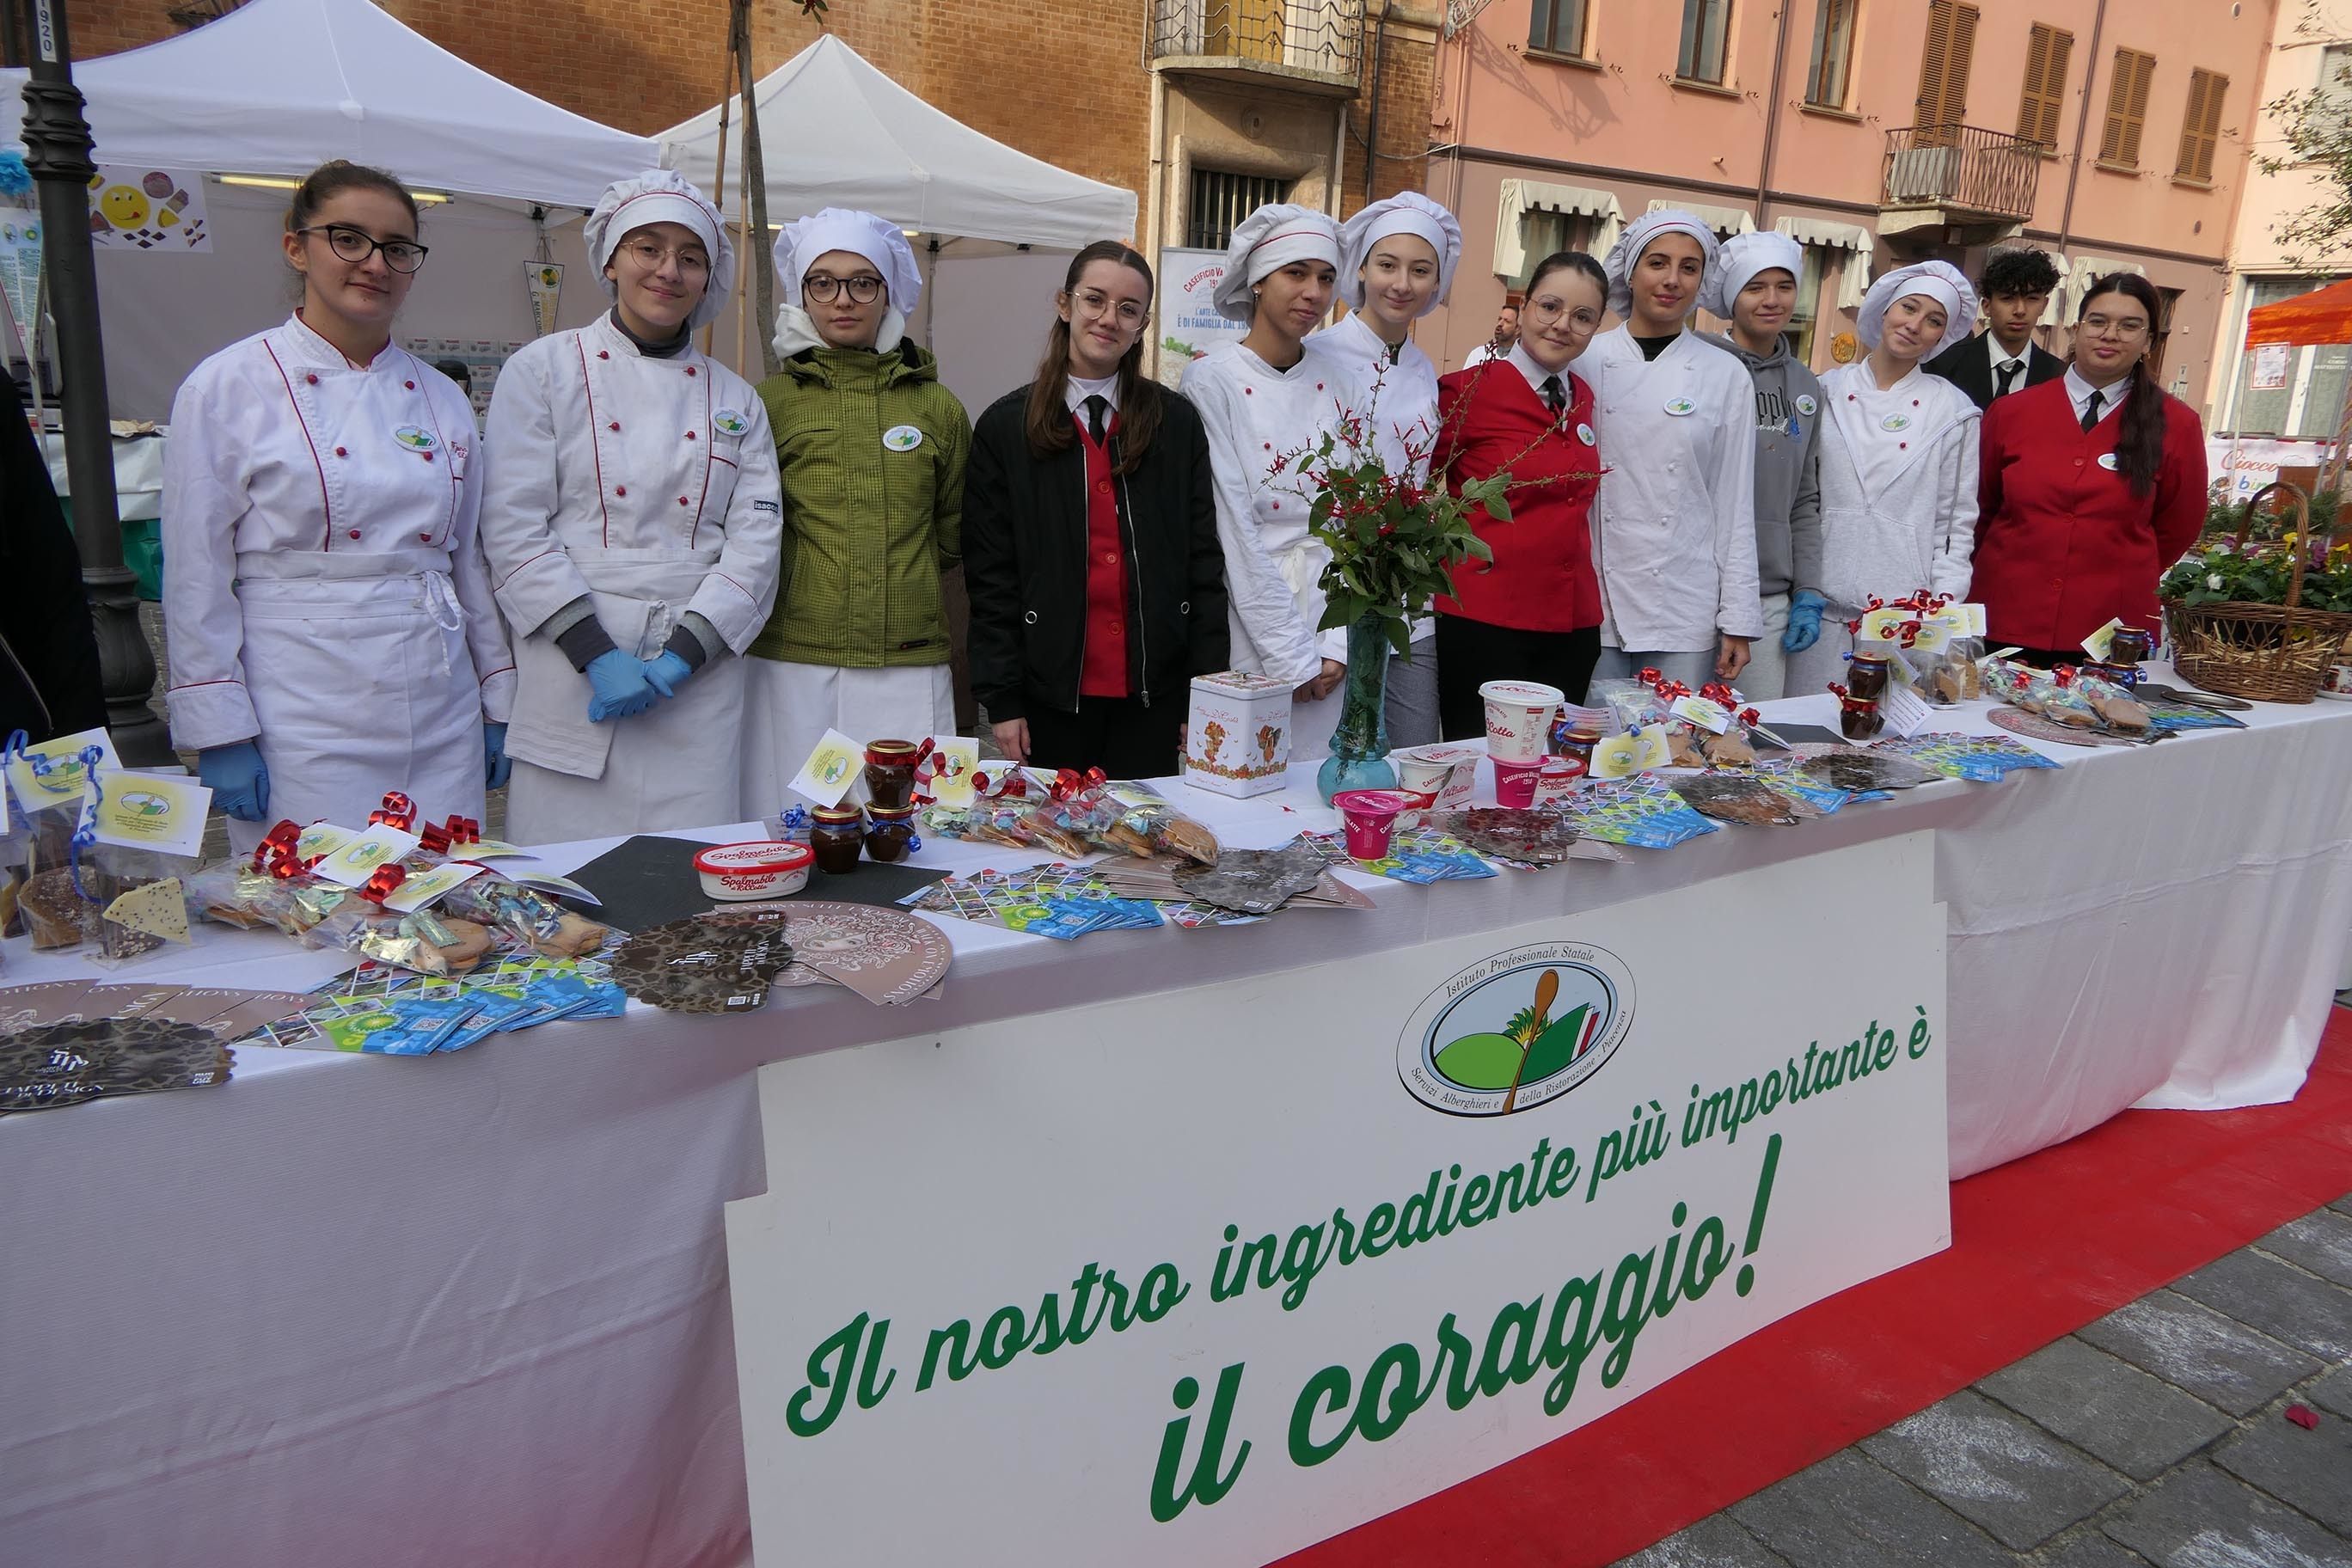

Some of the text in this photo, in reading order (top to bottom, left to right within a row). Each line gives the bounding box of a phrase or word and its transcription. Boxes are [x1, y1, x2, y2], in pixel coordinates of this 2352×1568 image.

[1183, 268, 1216, 293] CASEIFICIO
[1183, 317, 1190, 328] DI
[1191, 318, 1222, 328] FAMIGLIA
[1223, 320, 1235, 329] DAL
[1755, 386, 1800, 436] pply
[720, 873, 777, 887] Spalmabile
[1446, 946, 1595, 998] Istituto Professionale Statale
[1411, 1067, 1438, 1097] Servizi
[1440, 1092, 1491, 1111] Alberghieri
[1519, 1090, 1542, 1105] della
[1545, 1057, 1596, 1095] Ristorazione
[1601, 1009, 1626, 1054] Piacenza
[786, 1005, 1930, 1437] Il nostro ingrediente più importante è
[1150, 1132, 1782, 1523] il coraggio!
